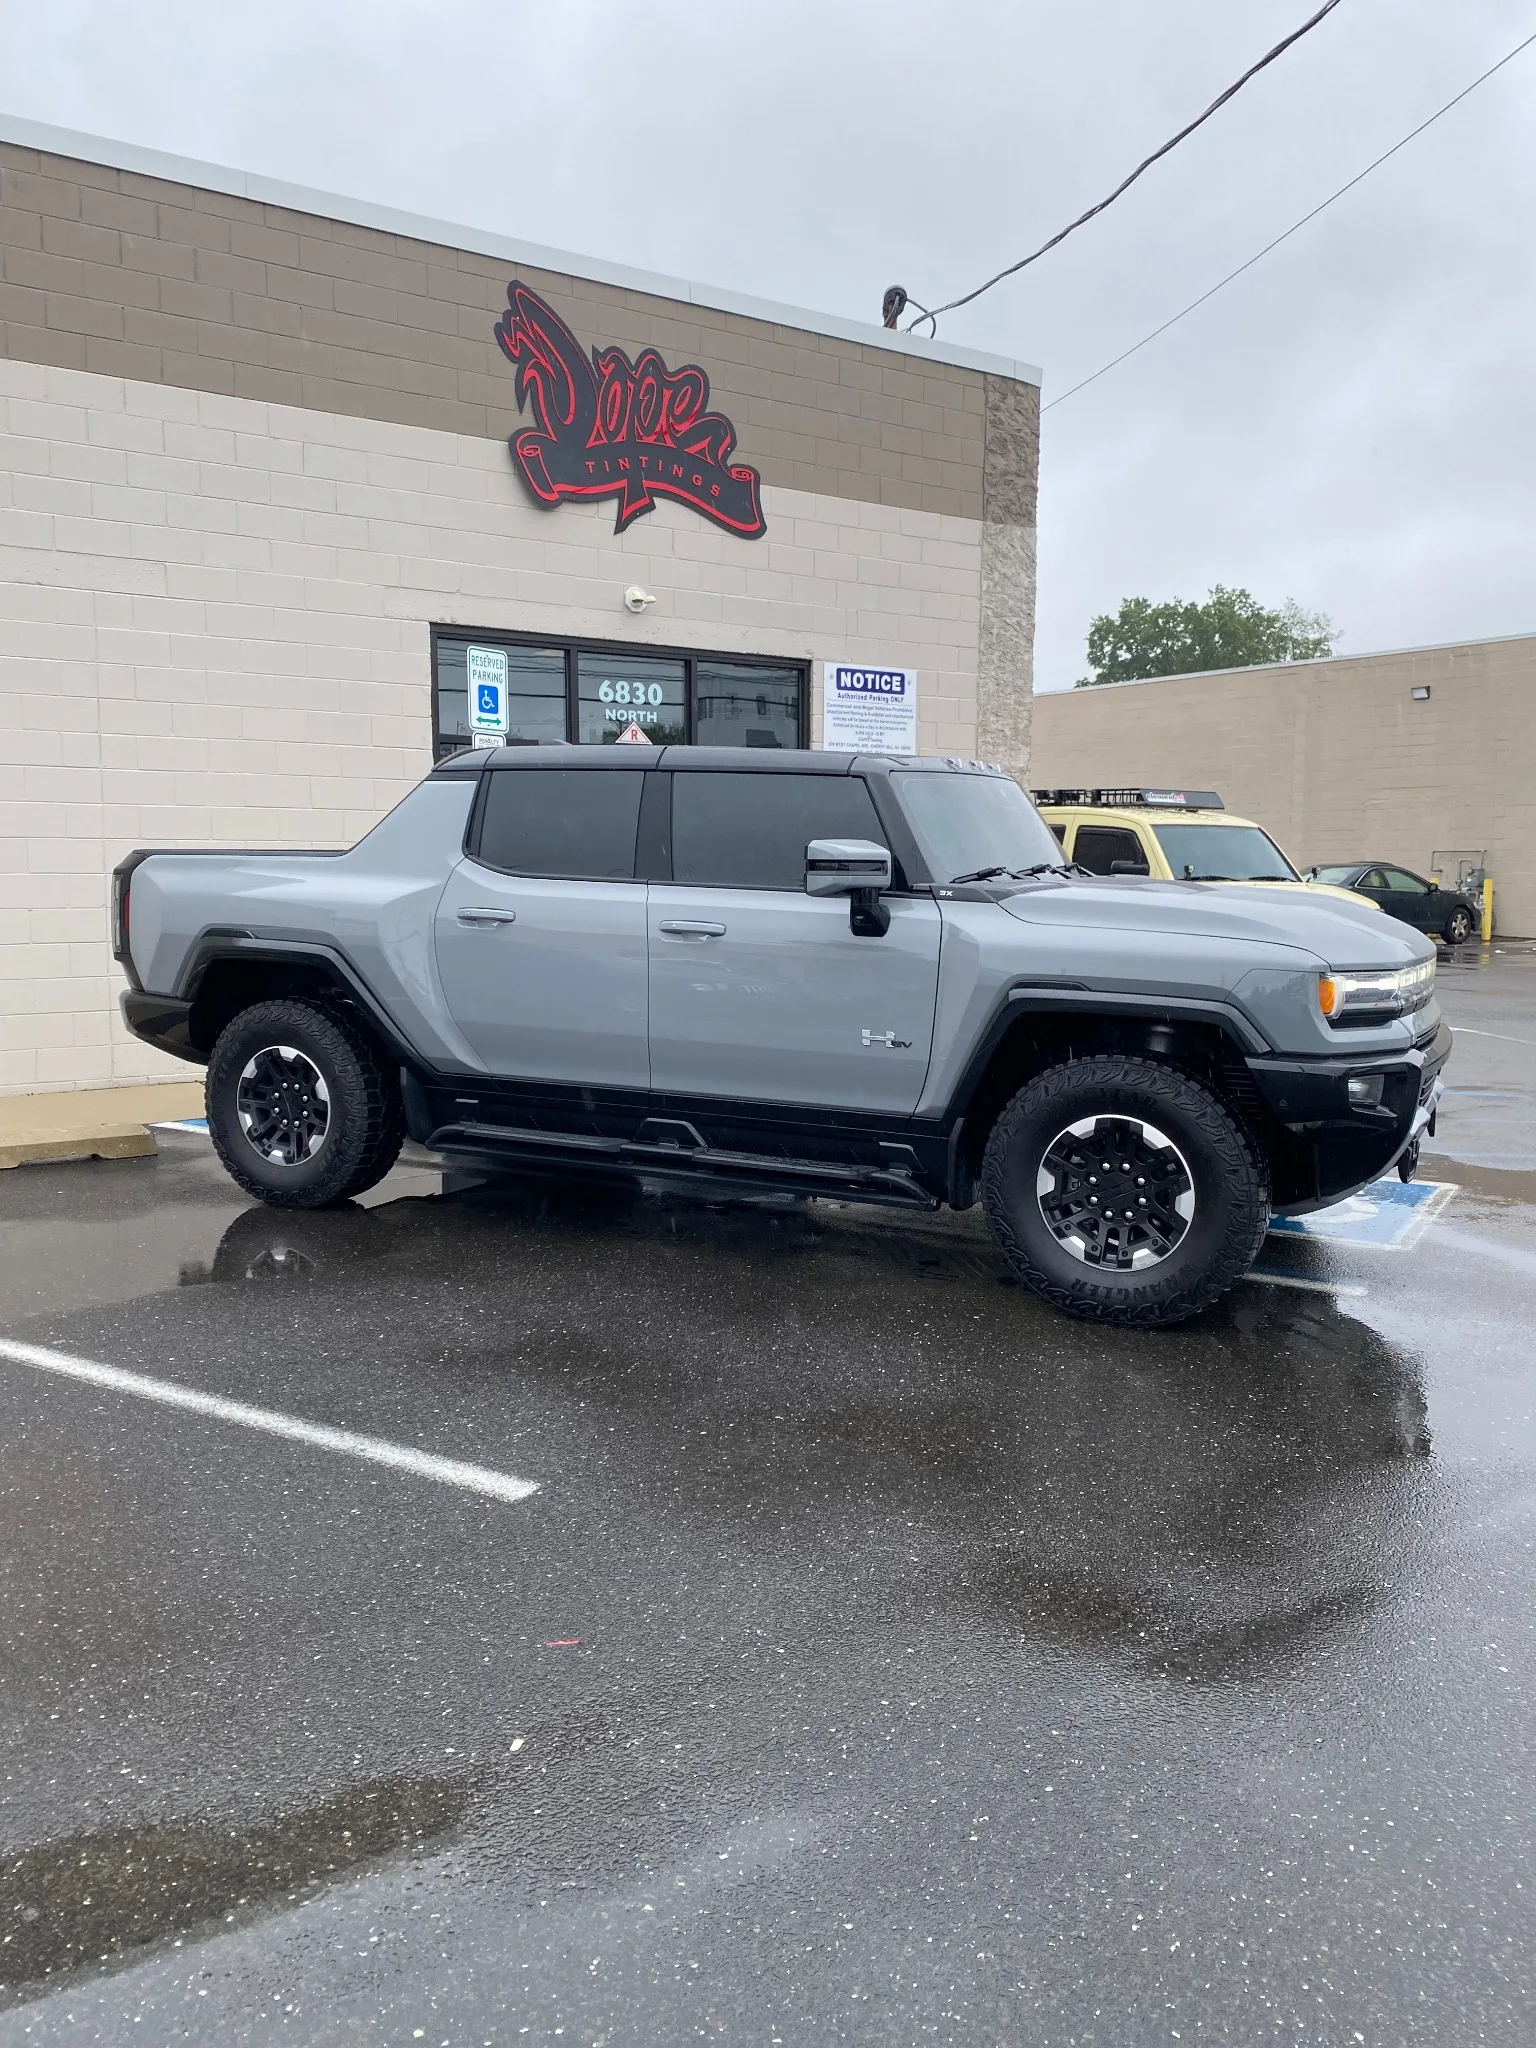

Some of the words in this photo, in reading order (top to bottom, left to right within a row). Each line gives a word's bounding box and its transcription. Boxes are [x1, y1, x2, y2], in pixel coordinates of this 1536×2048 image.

[585, 455, 721, 498] TINTINGS
[471, 654, 504, 670] RESERVED
[472, 669, 504, 684] PARKING
[840, 671, 902, 692] NOTICE
[598, 679, 663, 706] 6830
[837, 692, 868, 701] Authorized
[869, 695, 889, 704] Parking
[890, 695, 904, 703] ONLY
[605, 708, 658, 723] NORTH
[631, 729, 638, 741] R
